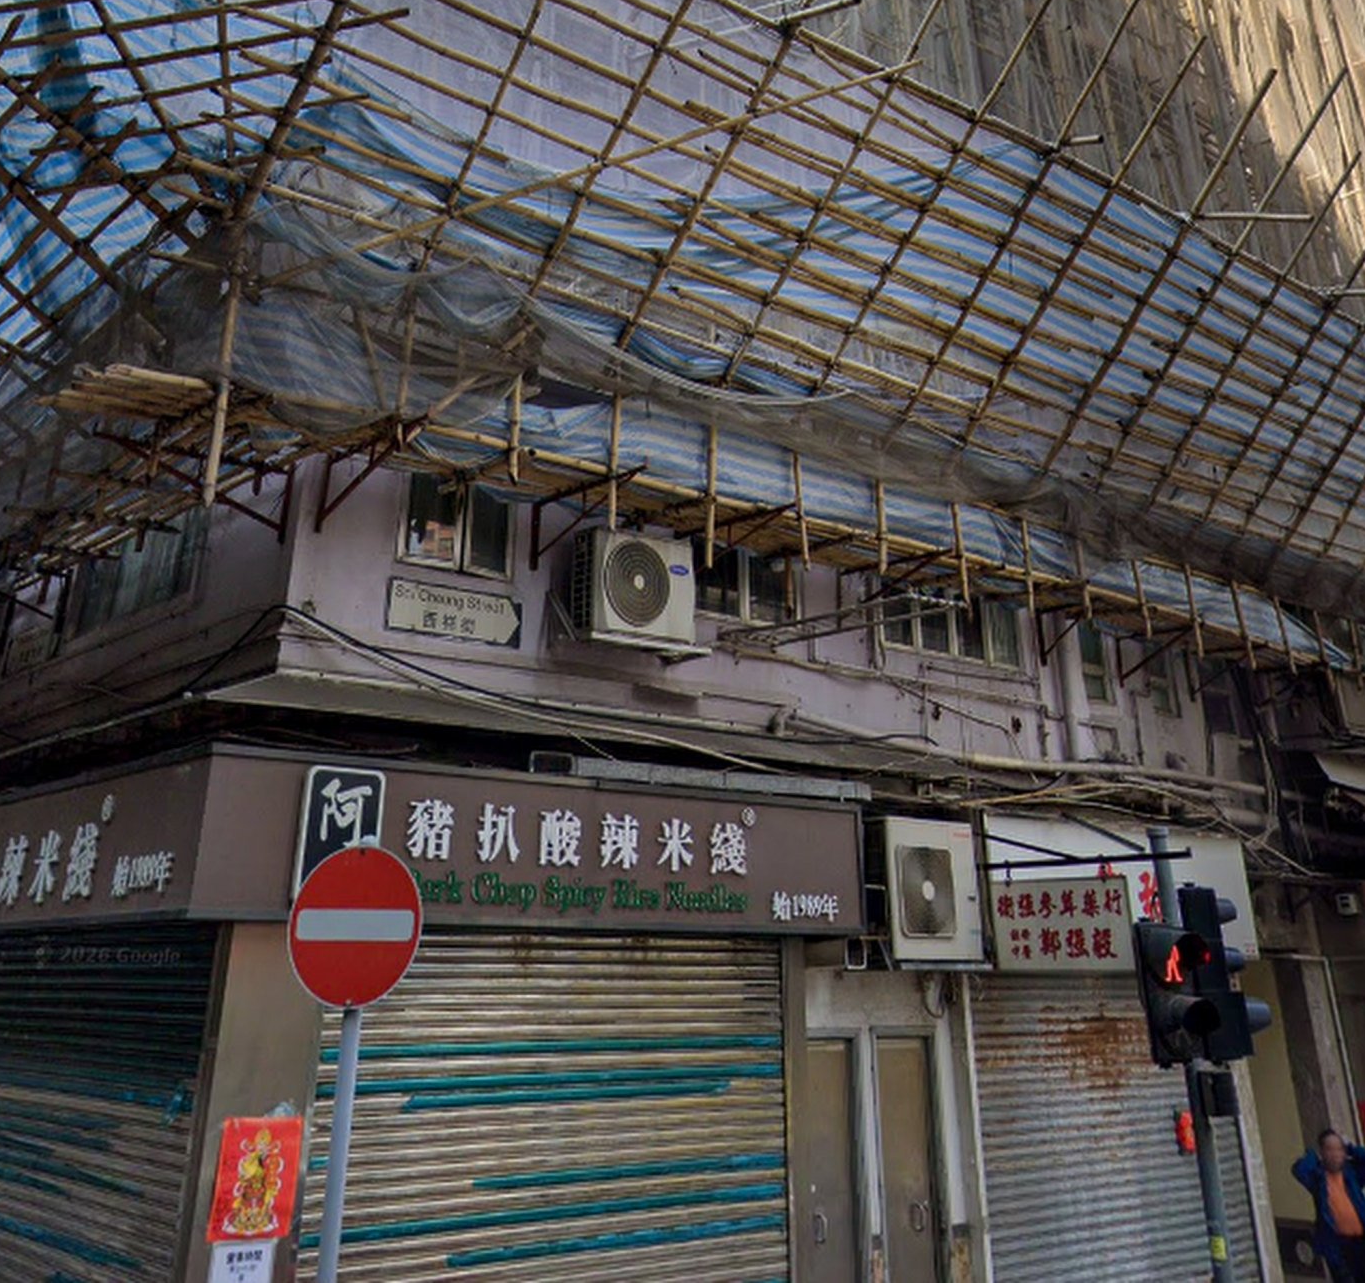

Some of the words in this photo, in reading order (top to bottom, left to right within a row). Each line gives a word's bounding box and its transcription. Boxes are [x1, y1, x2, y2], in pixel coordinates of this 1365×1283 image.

[417, 588, 464, 610] Cheung
[467, 596, 505, 615] Street
[471, 872, 537, 911] Chop
[543, 875, 608, 914] Spicy
[613, 878, 661, 910] Rice
[665, 881, 749, 913] Noodles
